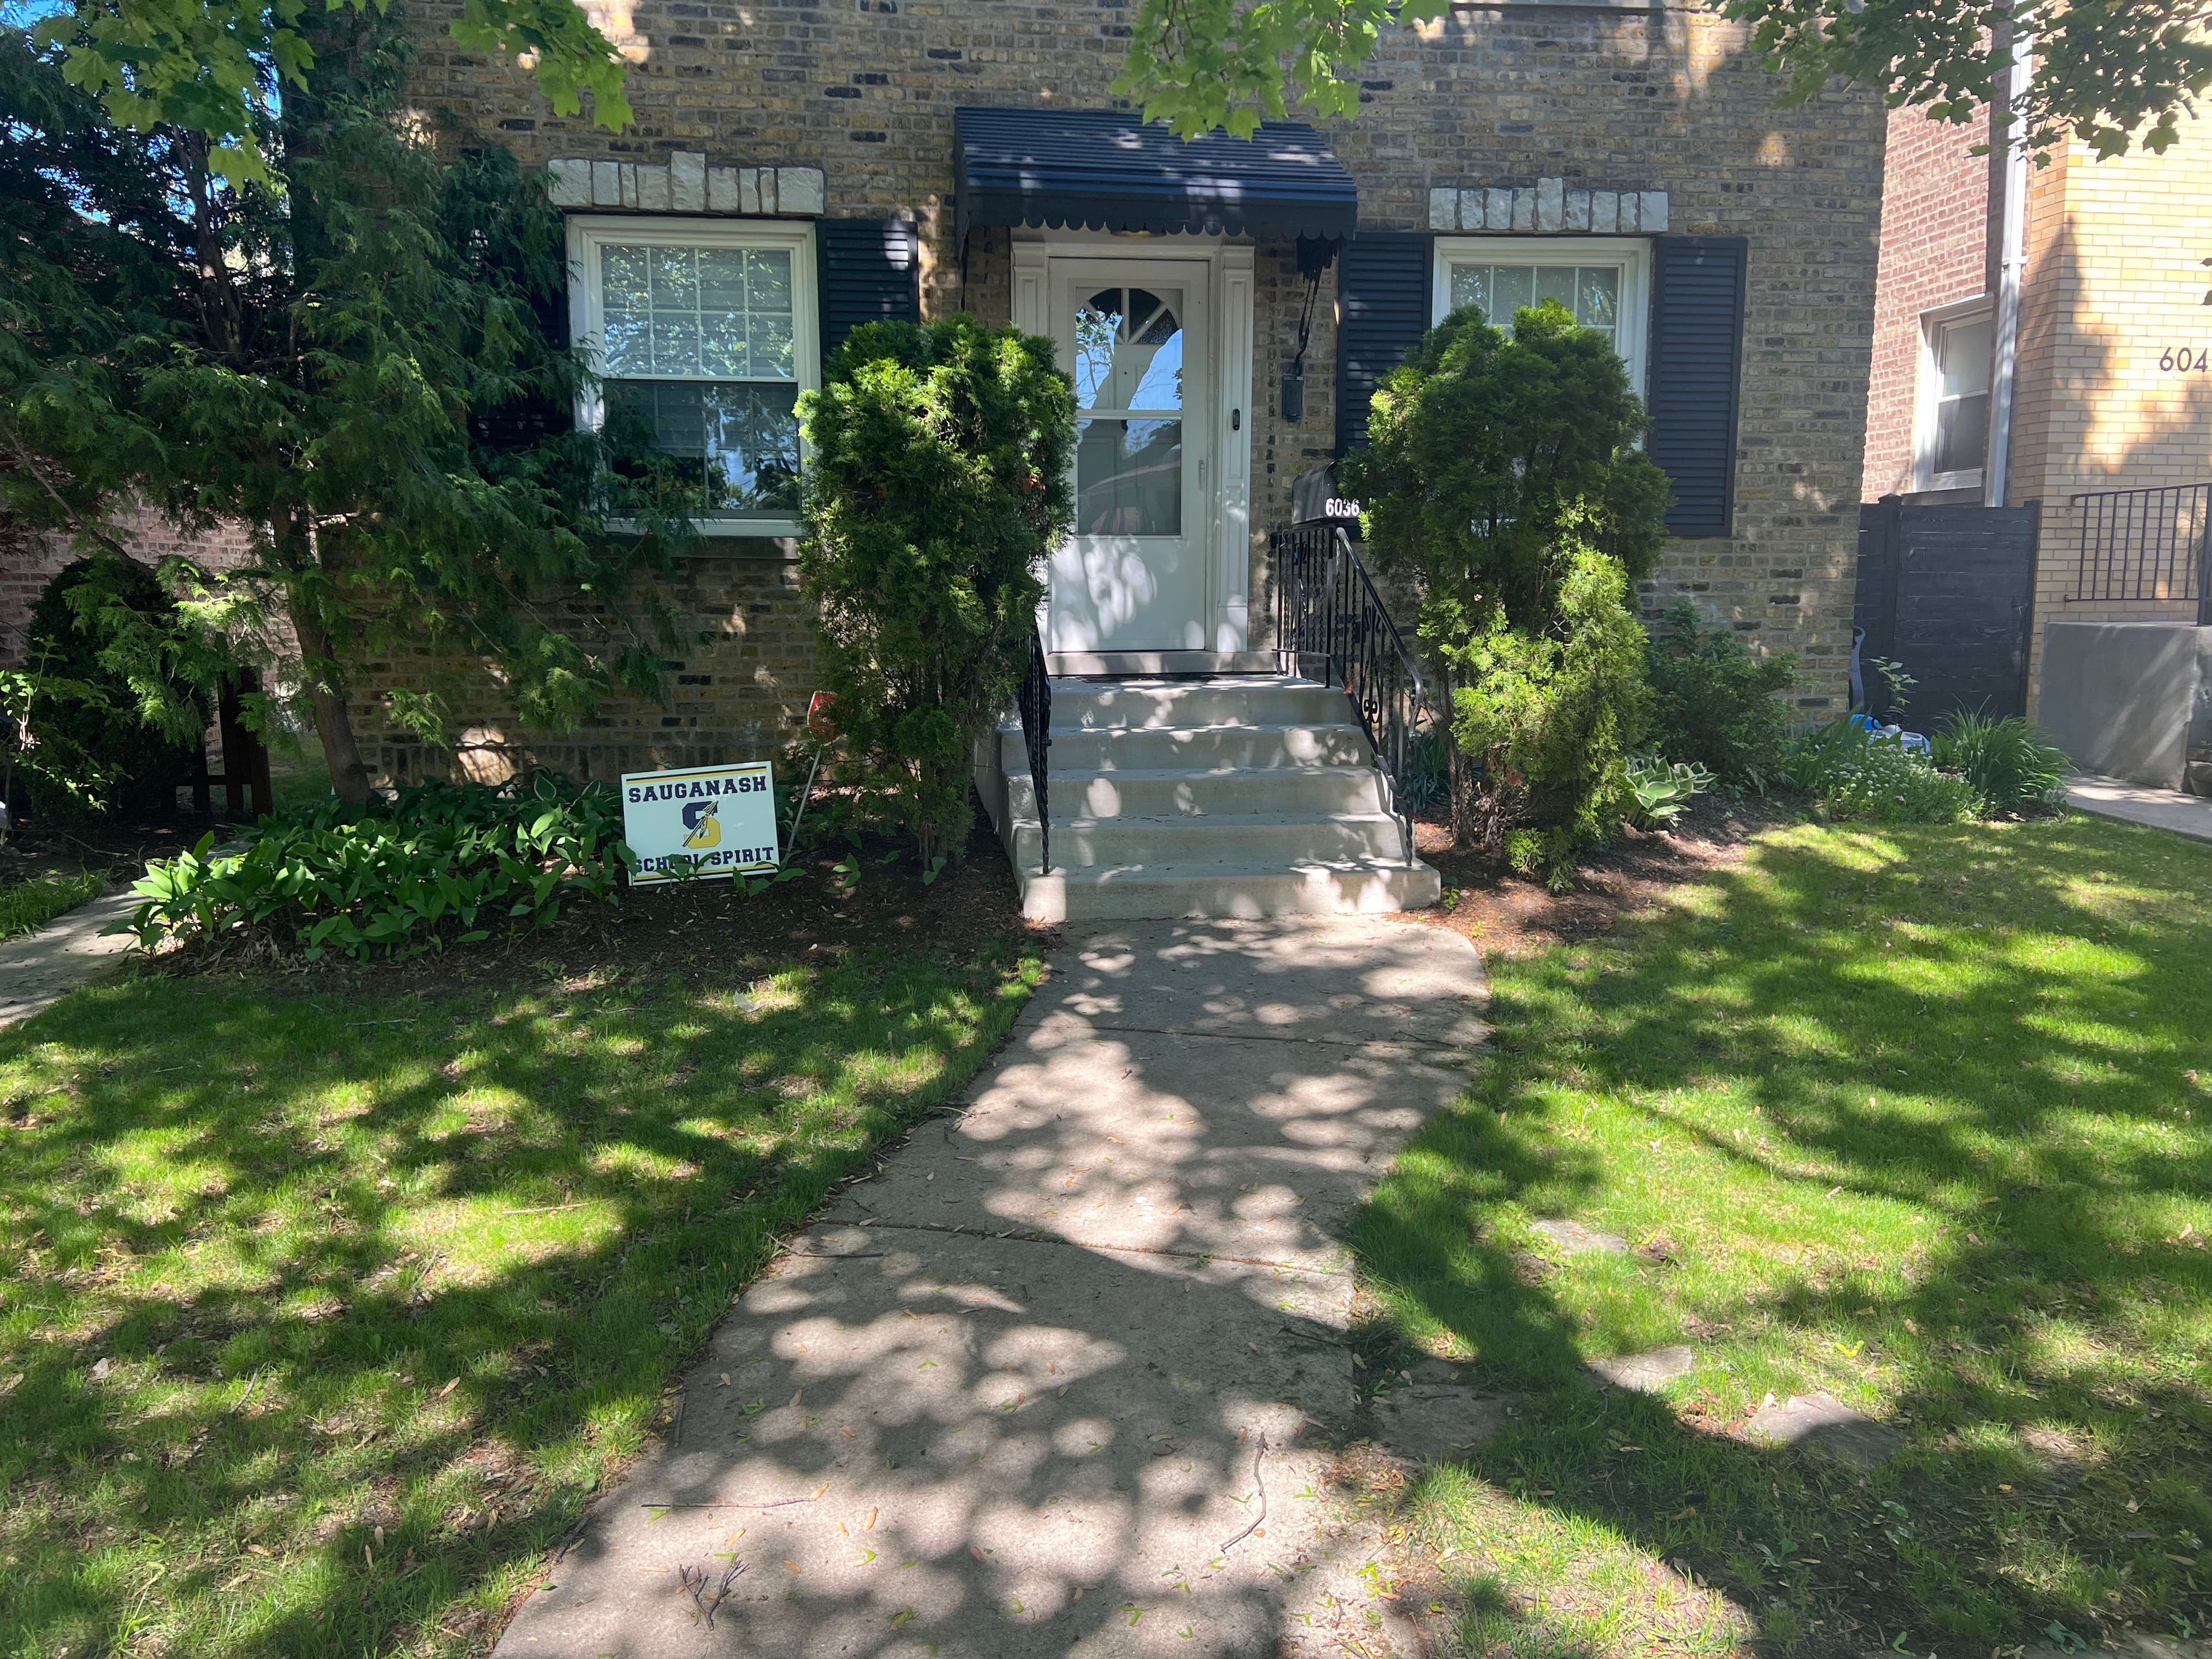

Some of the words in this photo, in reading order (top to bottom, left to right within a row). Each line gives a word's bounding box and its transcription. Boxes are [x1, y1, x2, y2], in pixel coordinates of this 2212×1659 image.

[2160, 347, 2208, 372] 604
[1325, 498, 1359, 517] 6036
[628, 776, 767, 802] SAUGANASH
[711, 847, 774, 865] SPIRIT
